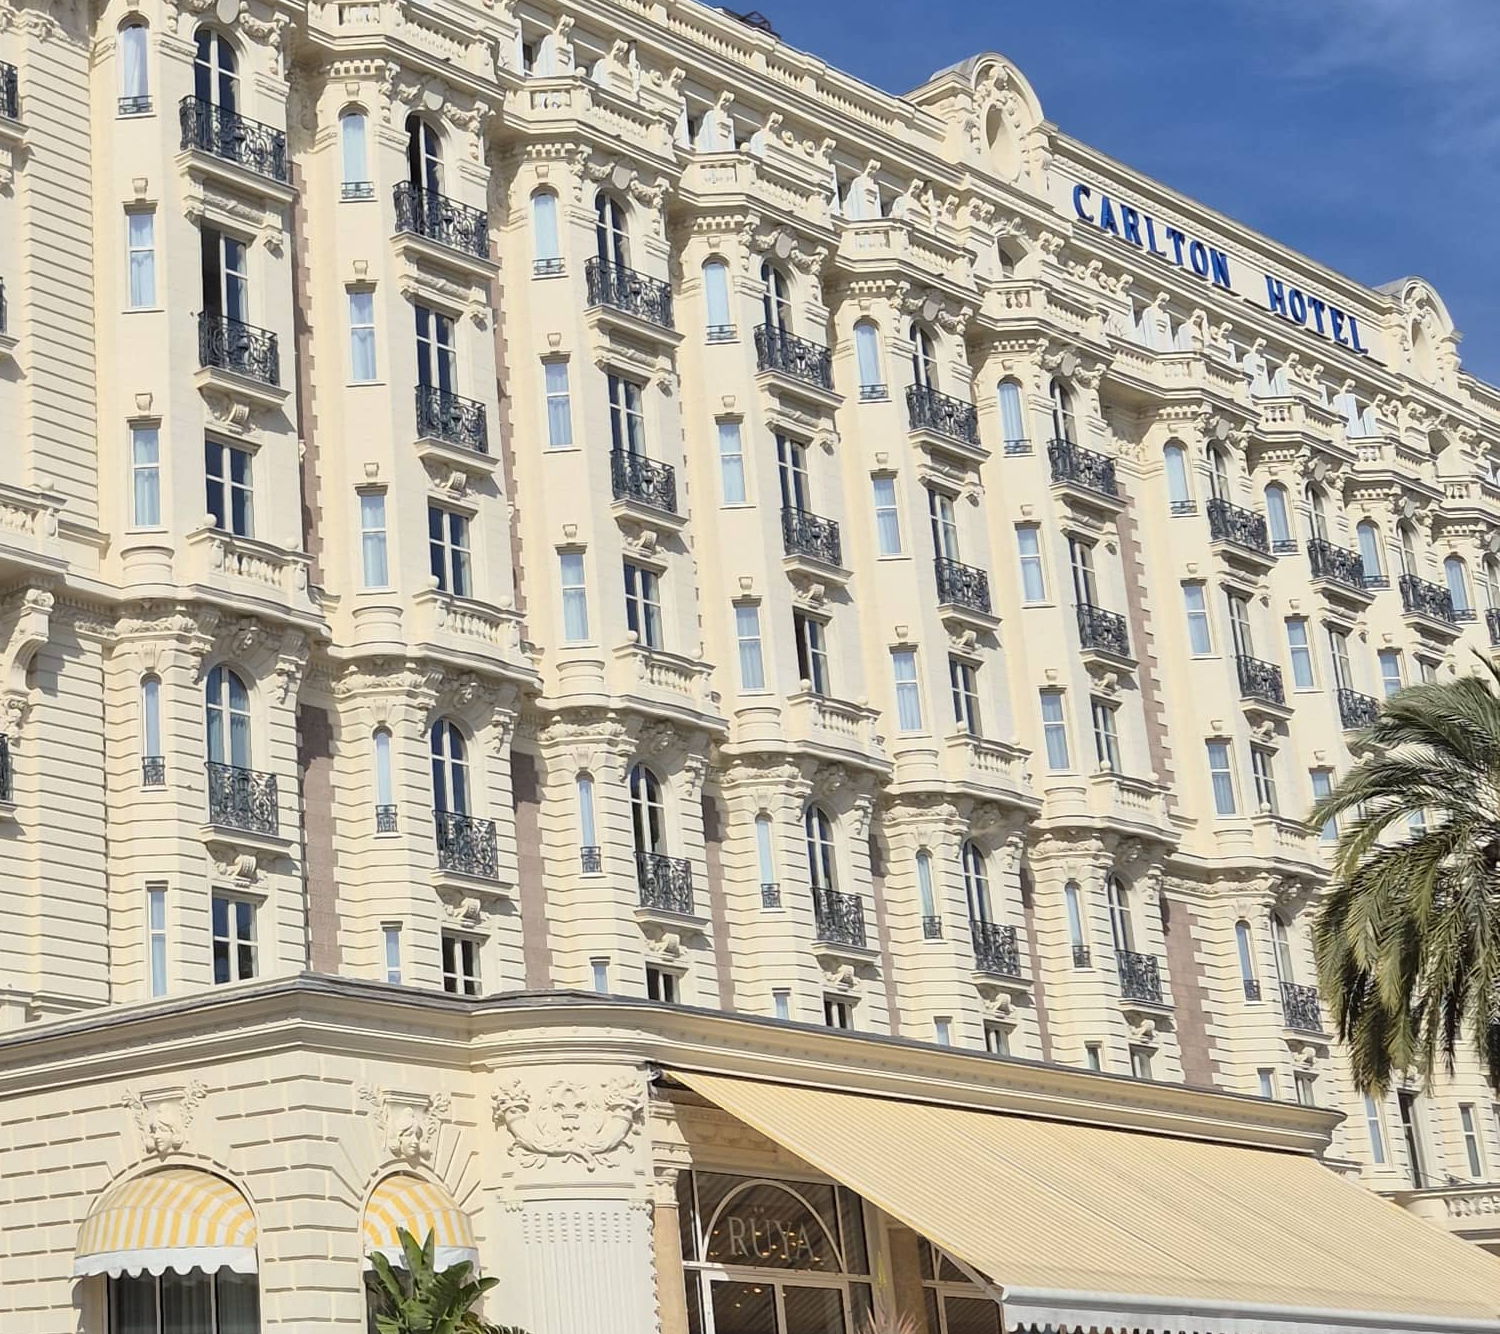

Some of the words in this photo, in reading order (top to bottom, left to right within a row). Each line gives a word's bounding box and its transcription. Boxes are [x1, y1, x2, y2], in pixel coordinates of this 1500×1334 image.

[1072, 183, 1233, 289] CARLTON
[1265, 274, 1370, 355] HOTEL
[727, 1207, 815, 1263] RÜYA
